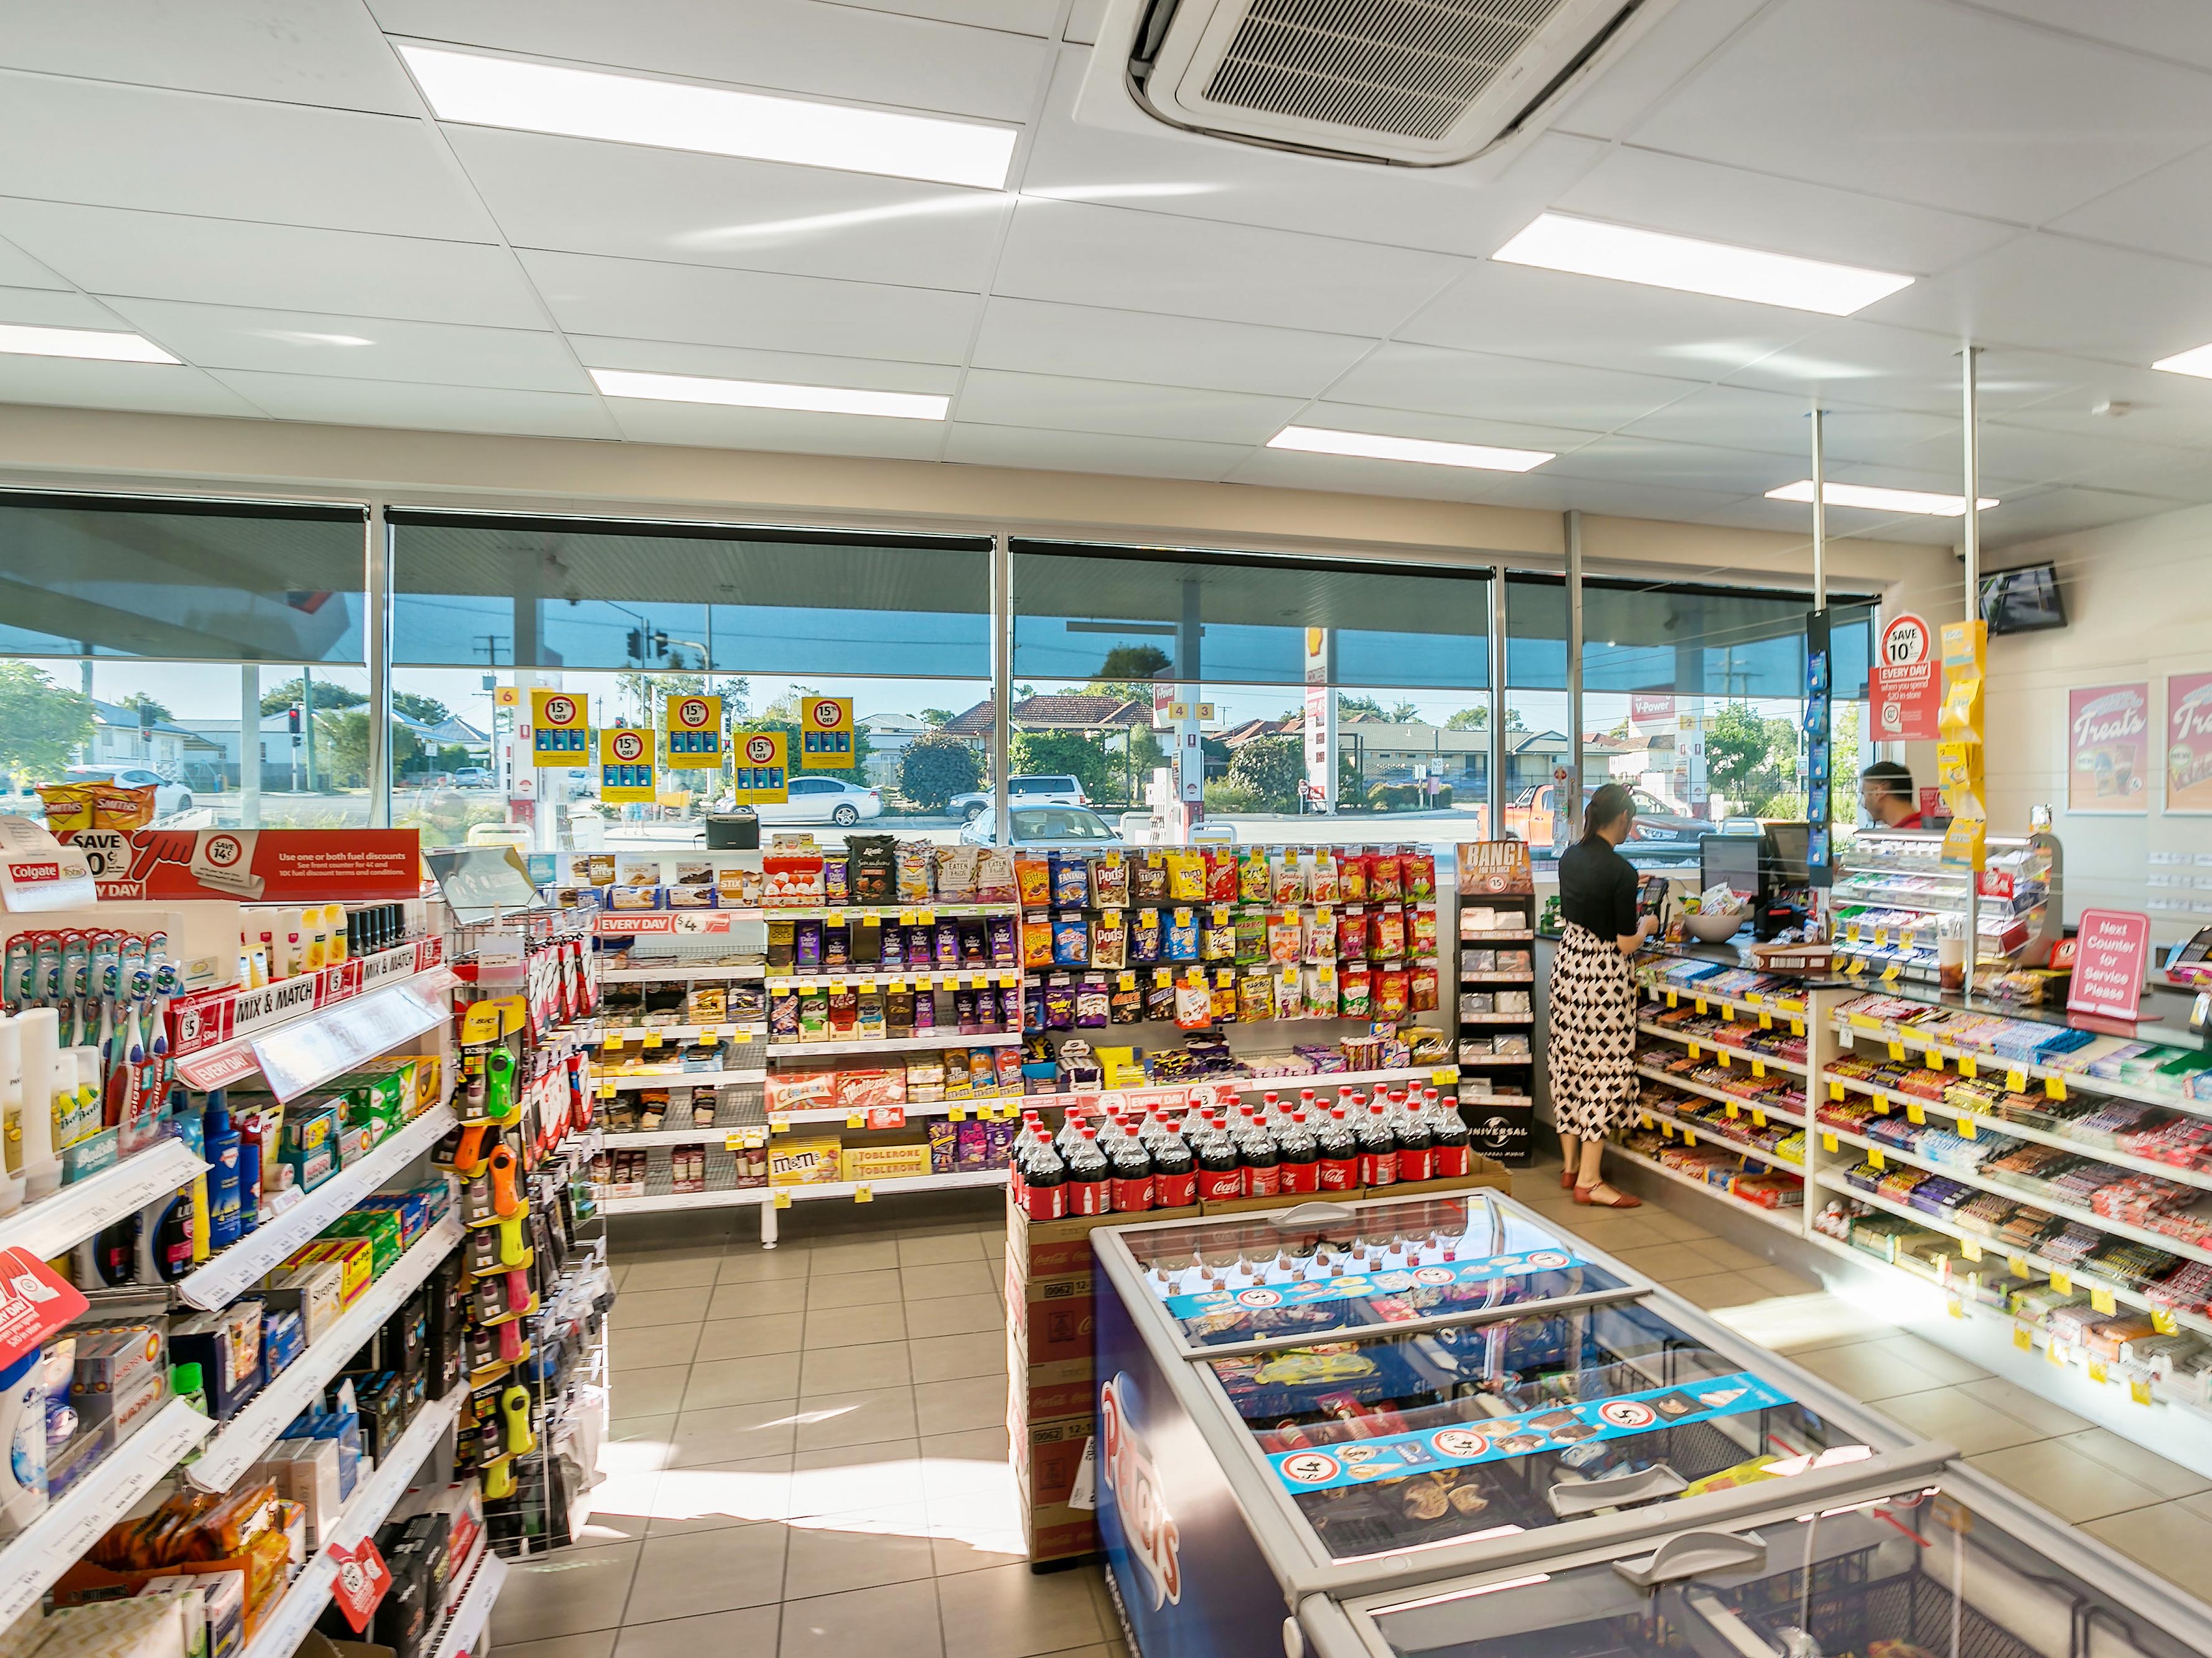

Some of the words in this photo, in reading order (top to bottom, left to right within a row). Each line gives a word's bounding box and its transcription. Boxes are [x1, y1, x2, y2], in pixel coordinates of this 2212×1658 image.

[1892, 627, 1917, 641] SAVE
[1882, 666, 1909, 679] EVERY
[1910, 663, 1927, 677] DAY
[1881, 683, 1897, 692] when
[1898, 683, 1910, 693] you
[1910, 679, 1929, 691] spend
[503, 691, 512, 702] 6
[1906, 691, 1921, 700] store
[1175, 706, 1184, 716] 4
[1201, 706, 1209, 716] 3
[1636, 701, 1670, 713] V-Power
[1686, 718, 1693, 728] 2
[2073, 707, 2147, 747] Treats
[73, 835, 121, 848] SAVE
[215, 841, 235, 851] SAVE
[279, 853, 295, 861] Use
[326, 853, 345, 861] both
[347, 853, 365, 861] fuel
[366, 852, 406, 861] discounts
[1466, 842, 1523, 867] BANG!
[12, 864, 57, 880] Colgate
[1023, 872, 1048, 885] Jaffas
[1098, 867, 1124, 885] Pods
[108, 884, 141, 897] DAY
[720, 879, 741, 888] STIX
[602, 919, 641, 930] EVERY
[643, 919, 668, 929] DAY
[2099, 920, 2128, 937] Next
[1025, 933, 1051, 947] Jaffas
[1097, 928, 1123, 944] Pods
[2086, 935, 2136, 953] Counter
[364, 959, 379, 981] MIX
[381, 958, 387, 974] &
[390, 950, 414, 972] MATCH
[2099, 952, 2117, 967] for
[2084, 966, 2129, 985] Service
[1246, 980, 1270, 989] HARIBO
[2083, 982, 2125, 1001] Please
[236, 995, 262, 1023] MIX
[265, 995, 273, 1013] &
[276, 981, 314, 1011] MATCH
[199, 1061, 232, 1082] EVERY
[227, 1054, 248, 1070] DAY
[1132, 1094, 1163, 1106] EVERY
[1164, 1091, 1184, 1104] DAY
[858, 1149, 920, 1161] TOBLERONE
[858, 1163, 921, 1177] TOBLERONE
[4, 1300, 27, 1317] DAY
